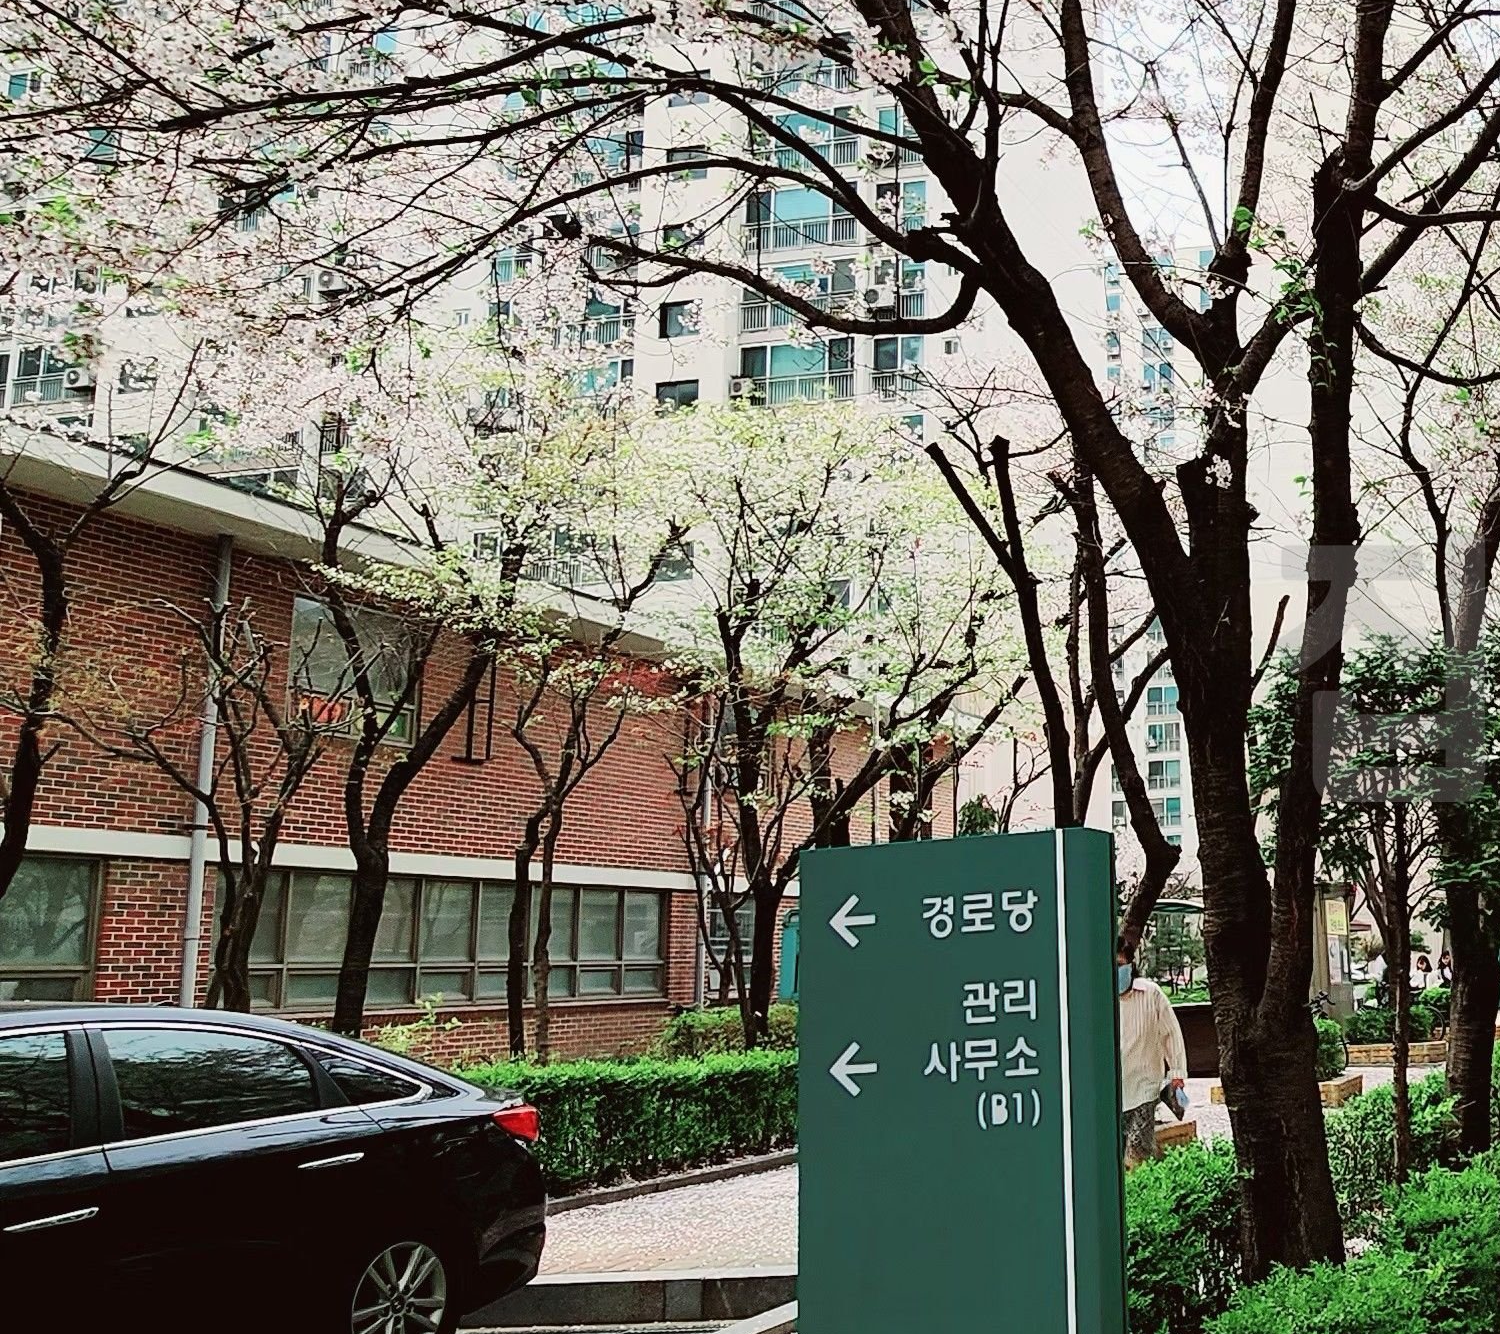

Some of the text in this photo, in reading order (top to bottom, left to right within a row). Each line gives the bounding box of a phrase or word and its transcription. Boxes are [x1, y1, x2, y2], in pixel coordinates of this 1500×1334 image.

[922, 889, 1039, 938] 경로당
[962, 979, 1037, 1024] 관리
[923, 1036, 1040, 1083] 사무소
[977, 1088, 1041, 1130] (B1)
